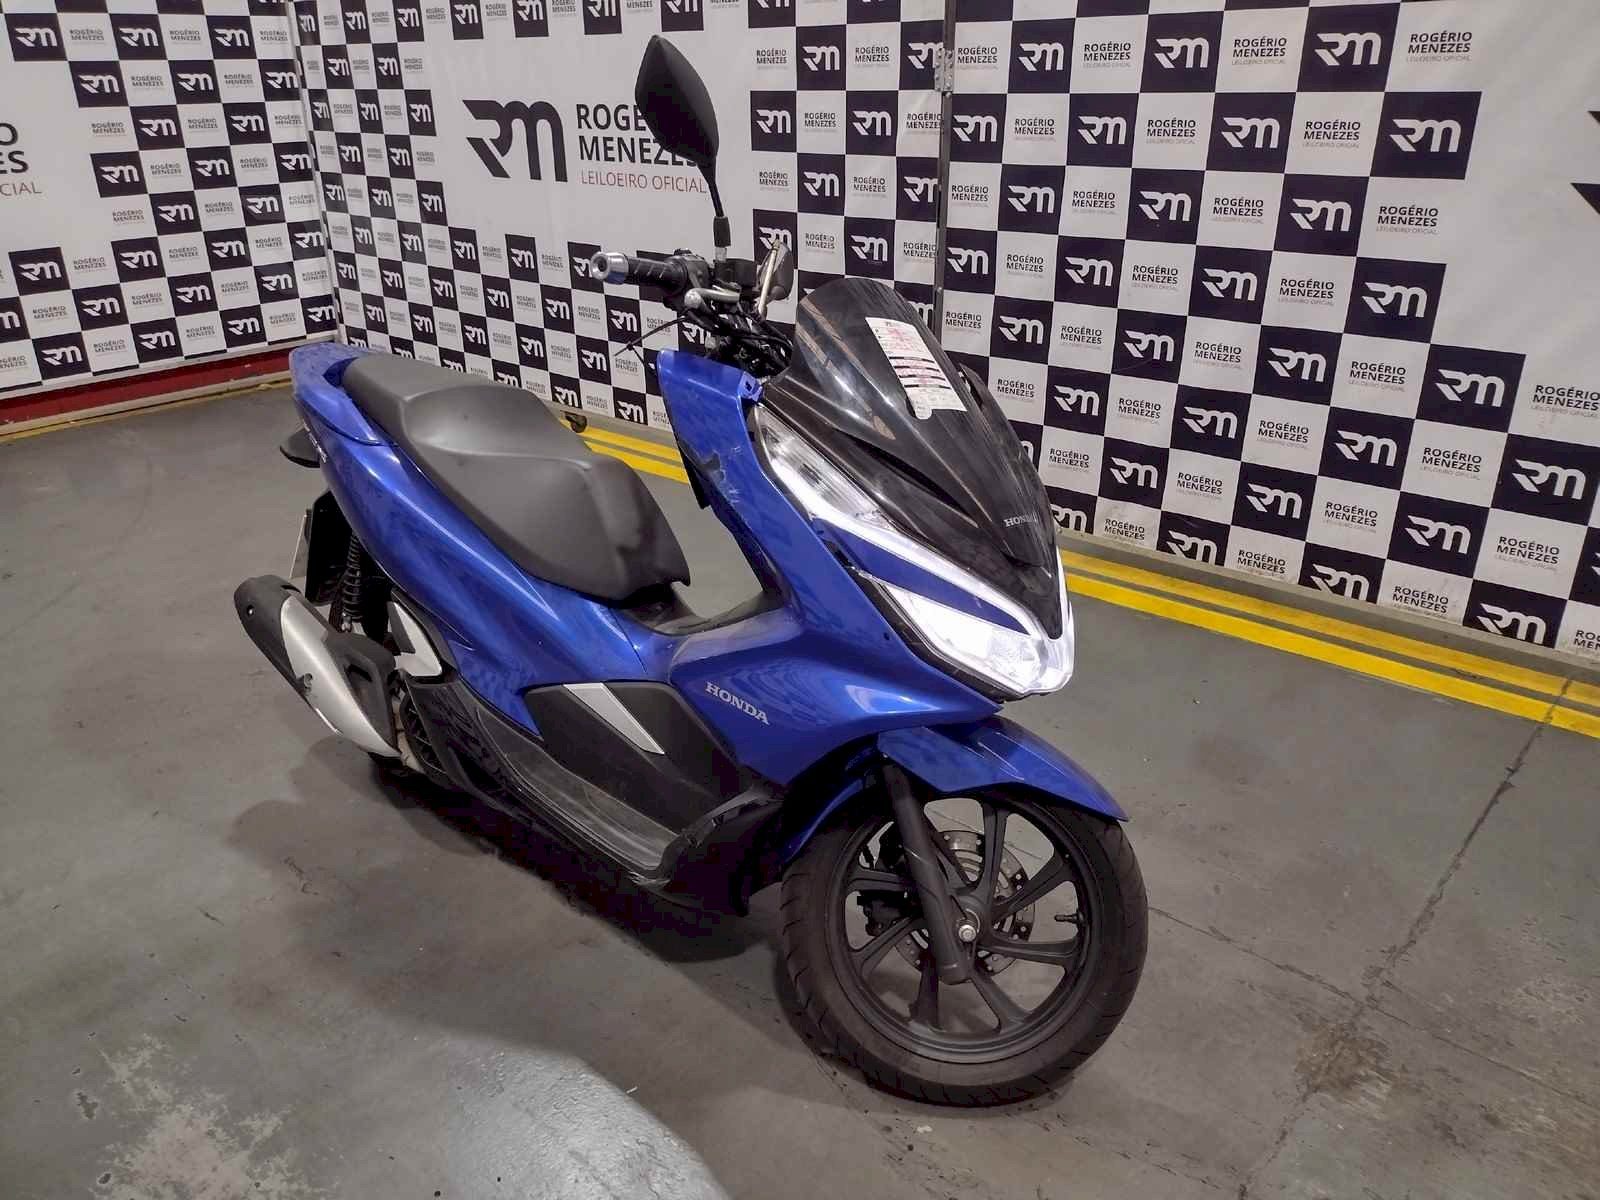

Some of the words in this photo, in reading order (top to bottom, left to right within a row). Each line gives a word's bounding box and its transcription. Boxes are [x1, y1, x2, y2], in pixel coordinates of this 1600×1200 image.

[1234, 36, 1286, 47] ROGÉRIO
[1411, 30, 1472, 42] ROGÉRIO
[958, 45, 998, 54] ROGÉRIO
[1084, 41, 1131, 52] ROGÉRIO
[1408, 43, 1470, 53] MENEZES
[855, 54, 889, 62] MENEZES
[1084, 52, 1130, 61] MENEZES
[1233, 48, 1286, 57] MENEZES
[957, 55, 998, 63] MENEZES
[1015, 118, 1054, 126] ROGÉRIO
[1148, 118, 1196, 128] ROGÉRIO
[1306, 120, 1360, 130] ROGÉRIO
[1015, 127, 1054, 135] MENEZES
[1147, 128, 1195, 137] MENEZES
[1304, 131, 1359, 140] MENEZES
[581, 169, 647, 189] LEILOEIRO
[652, 175, 707, 194] OFICIAL
[760, 178, 788, 186] MENEZES
[854, 184, 886, 192] MENEZES
[952, 185, 988, 194] ROGÉRIO
[952, 193, 988, 201] MENEZES
[1074, 191, 1115, 200] ROGÉRIO
[1072, 199, 1115, 208] MENEZES
[1215, 198, 1263, 208] ROGÉRIO
[1213, 207, 1263, 216] MENEZES
[1380, 205, 1438, 217] ROGÉRIO
[1378, 216, 1437, 226] MENEZES
[806, 240, 834, 249] MENEZES
[1007, 254, 1043, 264] ROGÉRIO
[1006, 262, 1043, 272] MENEZES
[1133, 265, 1178, 276] ROGÉRIO
[1132, 274, 1177, 284] MENEZES
[1281, 279, 1334, 290] ROGÉRIO
[1280, 287, 1334, 298] MENEZES
[946, 310, 981, 322] ROGÉRIO
[946, 319, 981, 328] MENEZES
[1062, 326, 1102, 336] ROGÉRIO
[1061, 333, 1102, 344] MENEZES
[1196, 342, 1241, 354] ROGÉRIO
[1195, 350, 1240, 363] MENEZES
[1352, 361, 1406, 375] ROGÉRIO
[1350, 370, 1405, 384] MENEZES
[998, 379, 1034, 390] ROGÉRIO
[998, 386, 1034, 398] MENEZES
[1536, 385, 1600, 400] ROGÉRIO
[1119, 398, 1161, 411] ROGÉRIO
[1533, 394, 1599, 410] MENEZES
[1119, 406, 1160, 418] MENEZES
[1260, 420, 1308, 434] ROGÉRIO
[1258, 428, 1308, 443] MENEZES
[1050, 448, 1089, 461] ROGÉRIO
[1424, 448, 1482, 463] ROGÉRIO
[1050, 456, 1088, 468] MENEZES
[1422, 456, 1480, 472] MENEZES
[1178, 472, 1222, 487] ROGÉRIO
[1177, 480, 1222, 494] MENEZES
[1326, 502, 1378, 518] ROGÉRIO
[1325, 510, 1376, 526] MENEZES
[1106, 519, 1144, 533] ROGÉRIO
[1105, 526, 1144, 540] MENEZES
[1499, 536, 1559, 555] ROGÉRIO
[1239, 550, 1285, 566] ROGÉRIO
[1497, 545, 1558, 564] MENEZES
[1238, 557, 1285, 574] MENEZES
[1394, 586, 1448, 604] ROGÉRIO
[1393, 594, 1447, 613] MENEZES
[705, 682, 770, 726] HONDA
